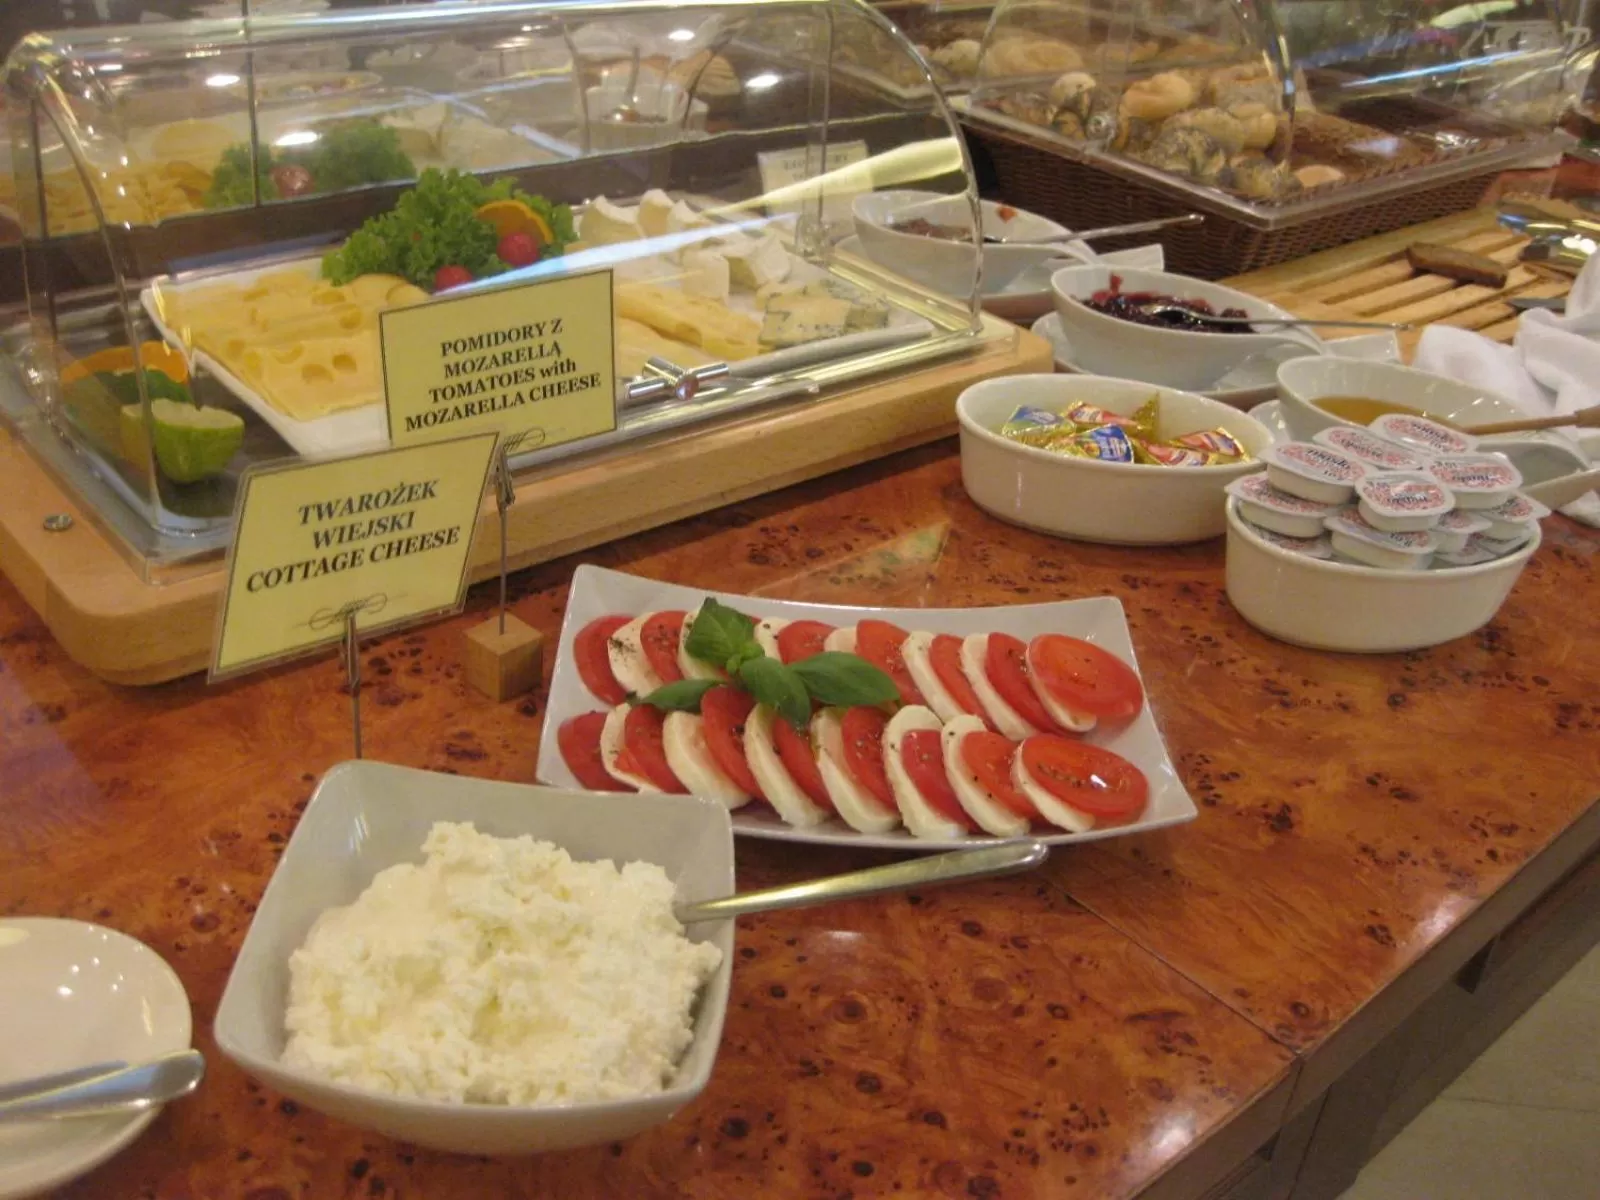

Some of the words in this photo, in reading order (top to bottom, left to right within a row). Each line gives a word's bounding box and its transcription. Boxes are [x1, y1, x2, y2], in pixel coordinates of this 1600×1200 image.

[440, 320, 547, 358] POMIDORY
[552, 318, 564, 334] Z
[444, 340, 562, 379] MOZARELLĄ
[404, 394, 526, 432] MOZARELLA
[529, 373, 602, 403] CHEESE
[429, 367, 536, 404] TOMATOES
[540, 358, 577, 379] with
[298, 479, 440, 525] TWAROŻEK
[312, 510, 416, 550] WIEJSKI
[246, 548, 365, 593] COTTAGE
[369, 526, 461, 563] CHEESE
